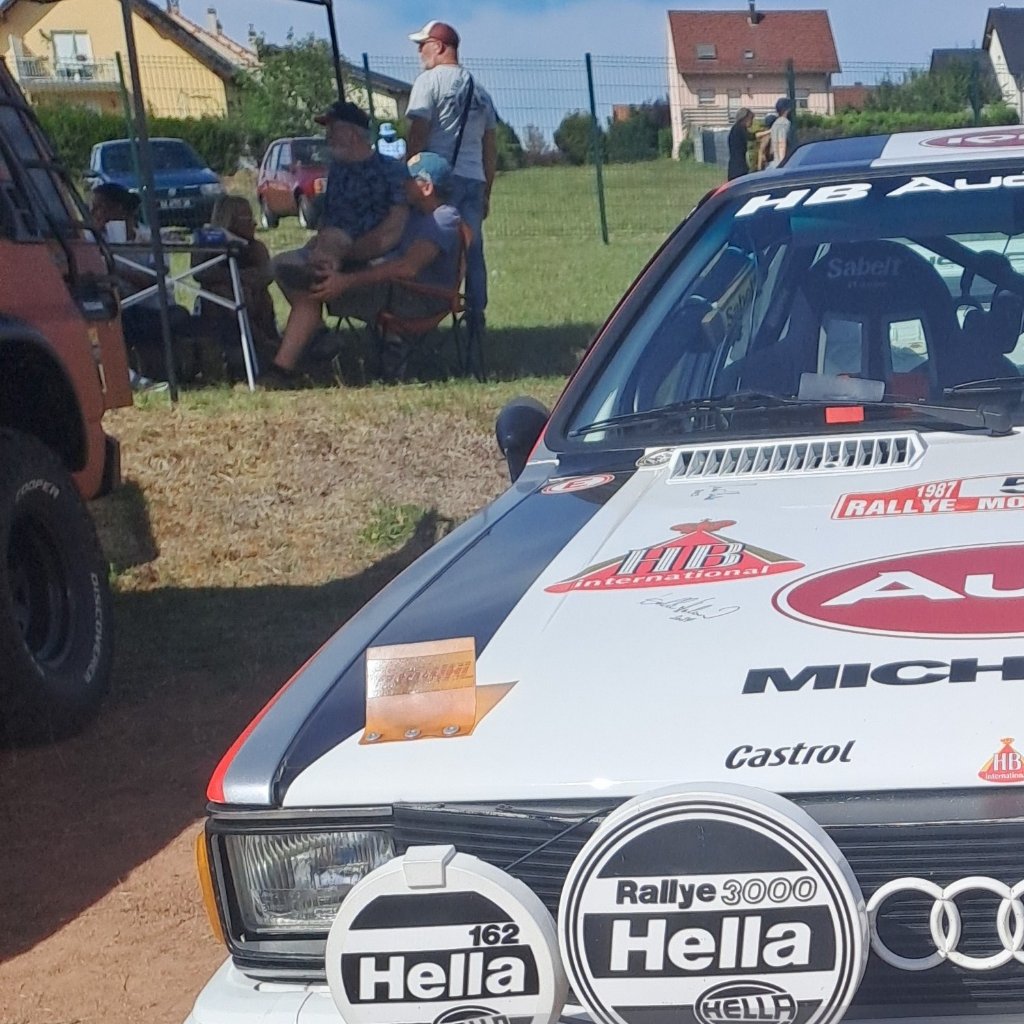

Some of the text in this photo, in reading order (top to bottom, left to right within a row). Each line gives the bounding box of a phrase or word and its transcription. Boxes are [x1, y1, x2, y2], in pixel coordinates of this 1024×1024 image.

[735, 180, 873, 218] HB
[827, 256, 903, 278] Sabelt
[916, 481, 958, 498] 1987
[844, 498, 958, 517] RALLYE
[616, 542, 746, 575] HB
[573, 563, 769, 590] international
[725, 739, 857, 770] Castrol
[993, 752, 1022, 771] HB
[615, 875, 818, 909] Rallye 3000
[468, 922, 521, 947] 162
[608, 914, 813, 972] Hella
[358, 952, 526, 1001] Hella
[702, 994, 796, 1022] HELLA
